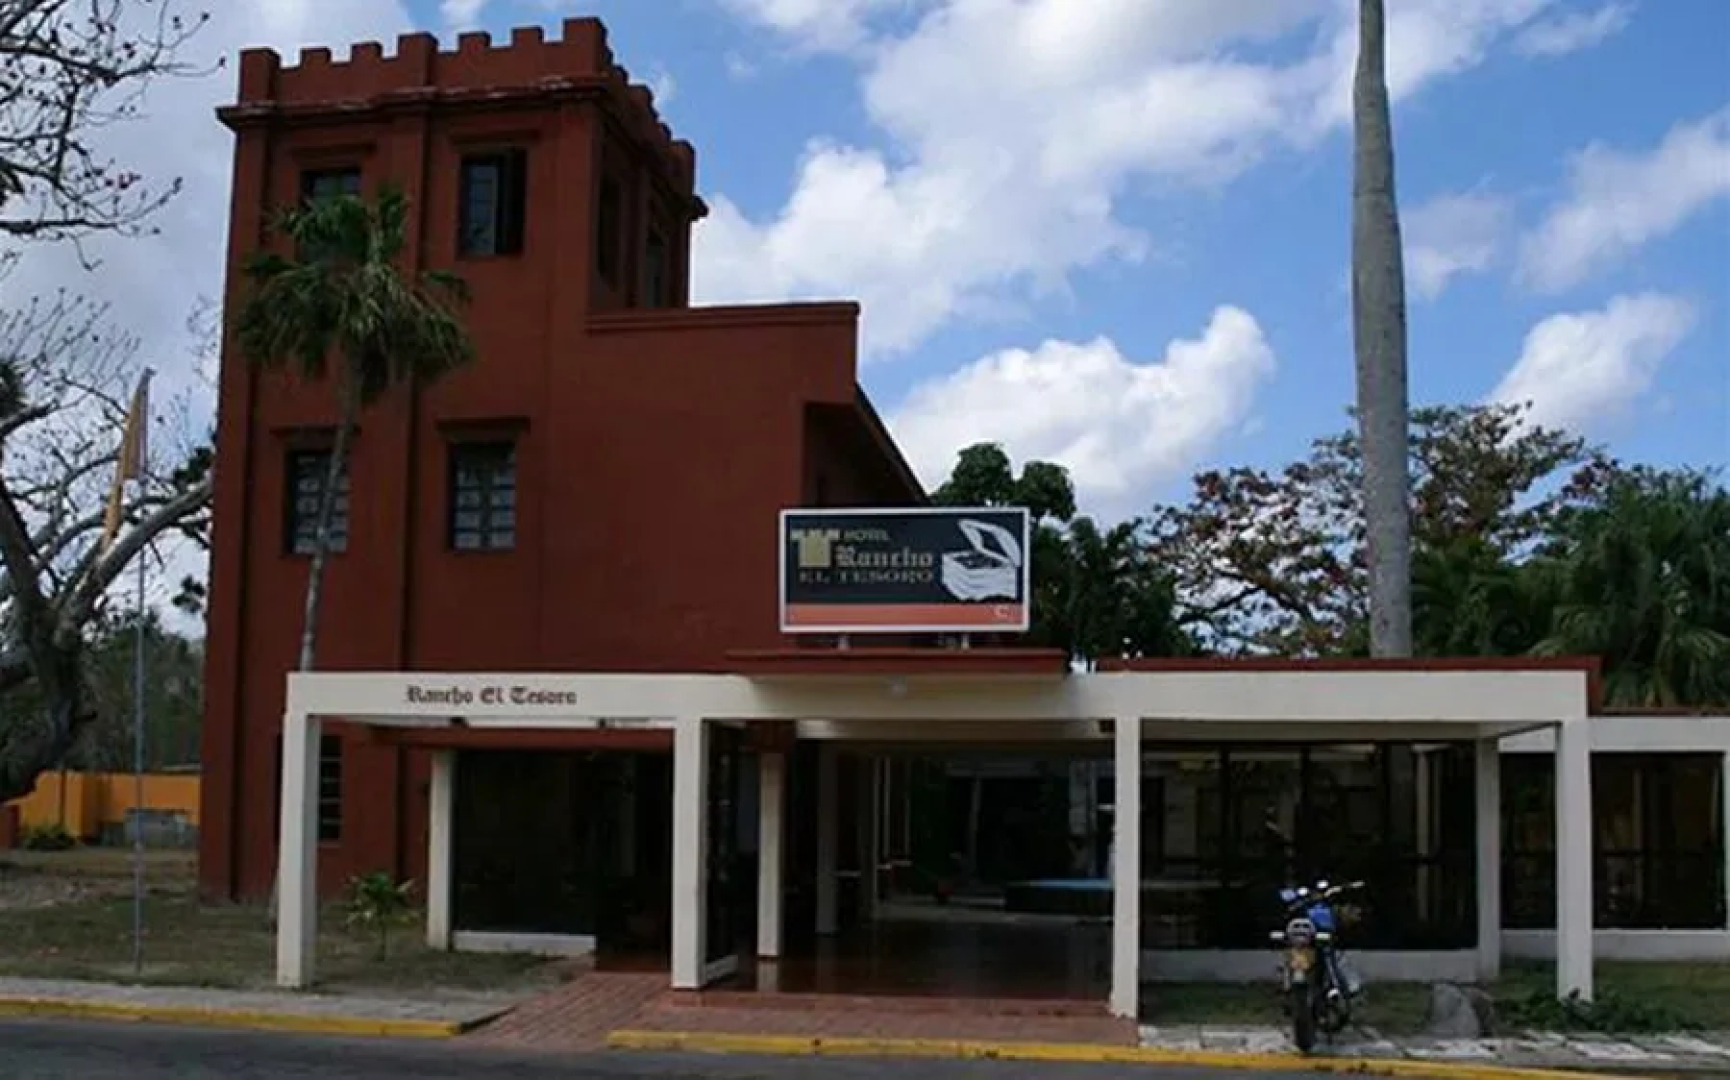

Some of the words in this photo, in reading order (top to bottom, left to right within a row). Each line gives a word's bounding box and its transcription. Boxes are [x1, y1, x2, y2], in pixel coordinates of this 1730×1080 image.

[836, 545, 933, 568] Rancho
[799, 570, 831, 583] EL
[838, 570, 933, 583] TESORO
[406, 684, 474, 705] Rancho
[480, 685, 504, 705] El
